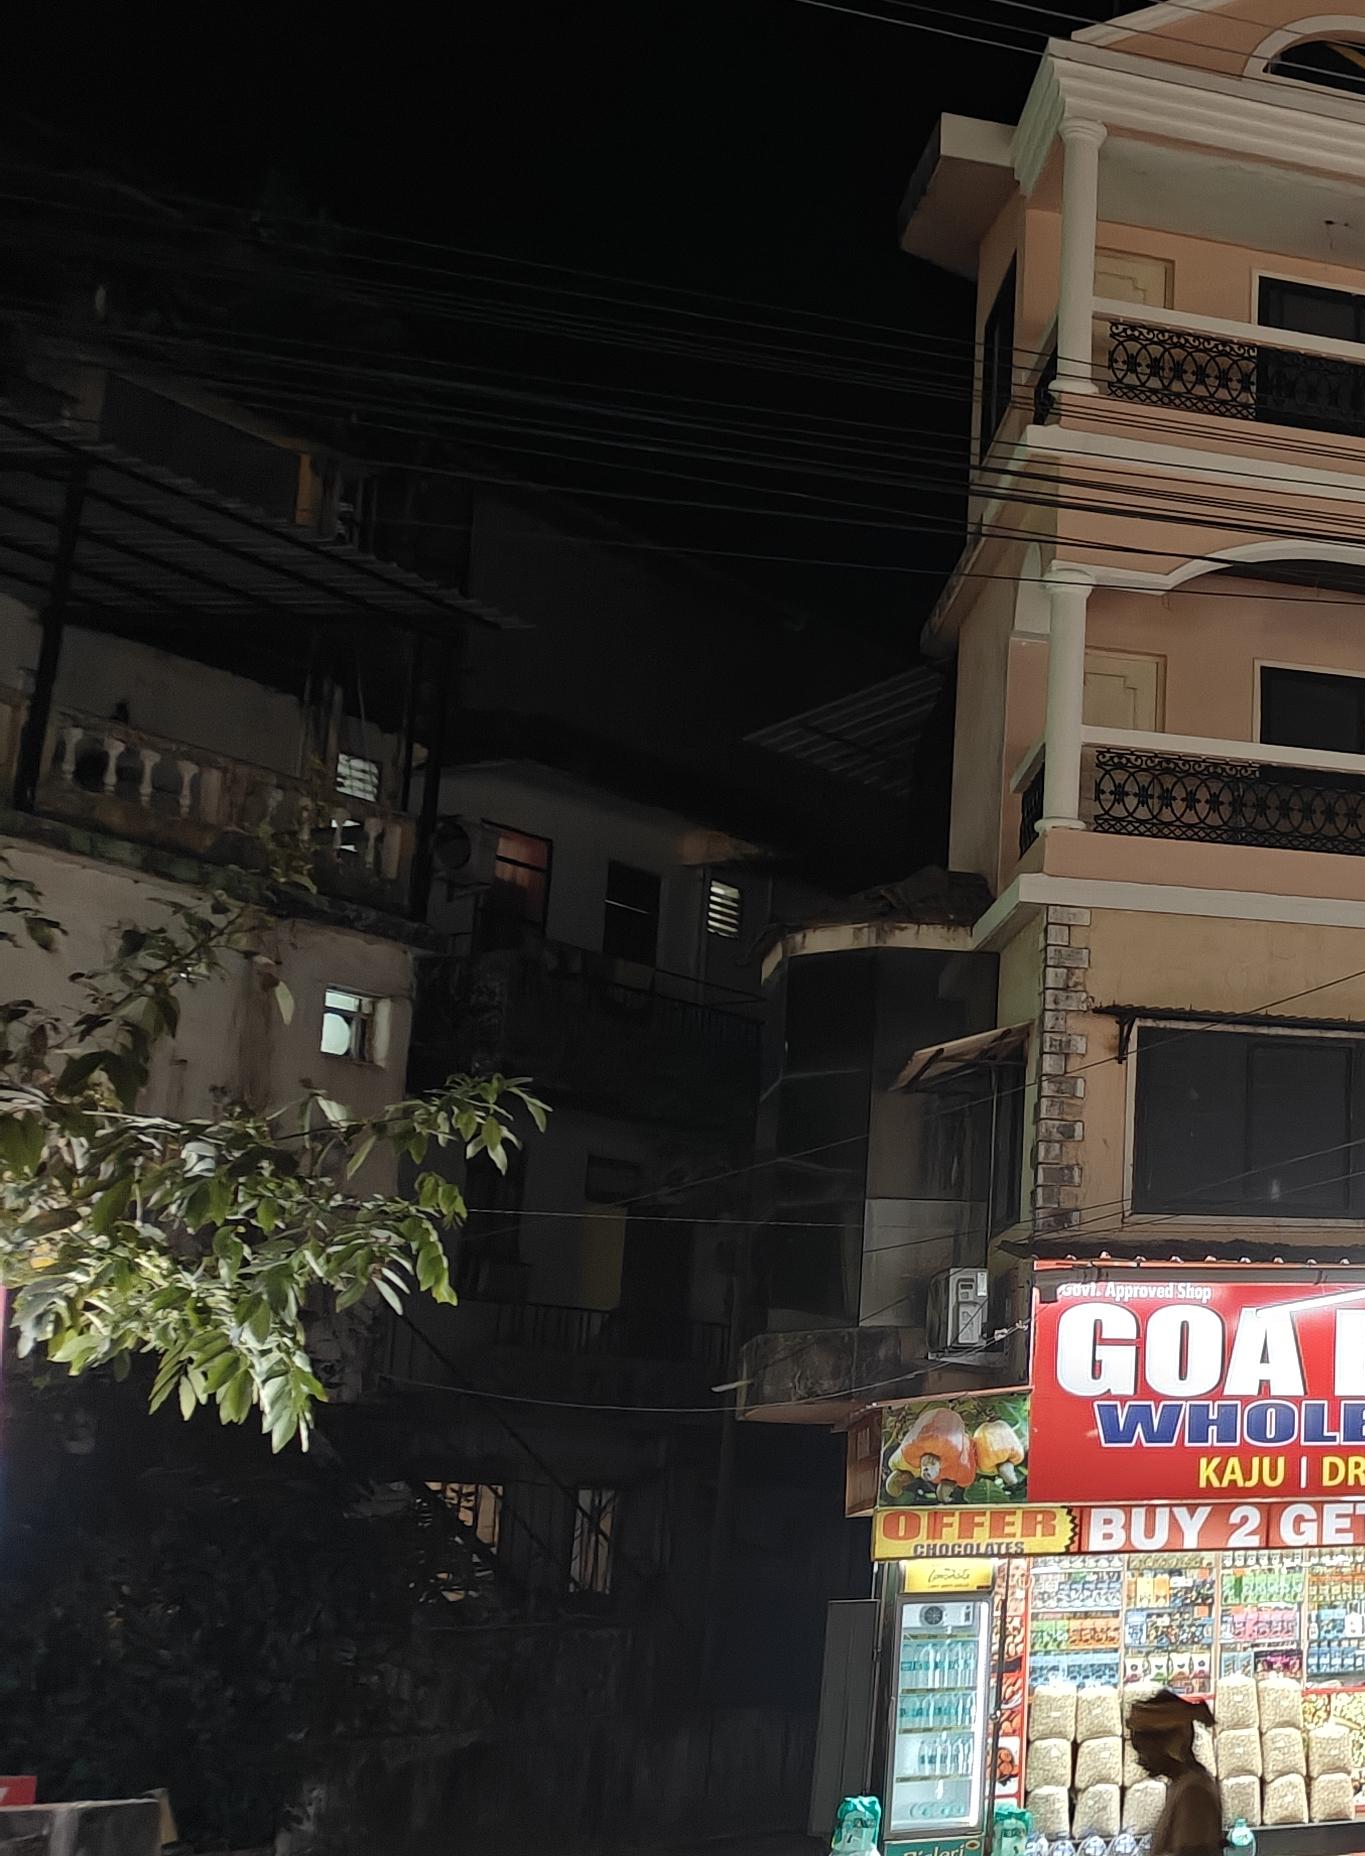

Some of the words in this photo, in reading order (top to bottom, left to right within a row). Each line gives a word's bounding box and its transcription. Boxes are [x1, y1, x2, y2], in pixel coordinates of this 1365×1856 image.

[1105, 1282, 1174, 1302] Approved
[1177, 1282, 1212, 1303] Shop
[1057, 1302, 1305, 1397] GOA
[1200, 1455, 1285, 1489] KAJU
[882, 1509, 1057, 1541] OFFER
[1088, 1506, 1213, 1551] BUY
[1227, 1507, 1261, 1549] 2
[913, 1541, 1025, 1556] CHOCOLATES
